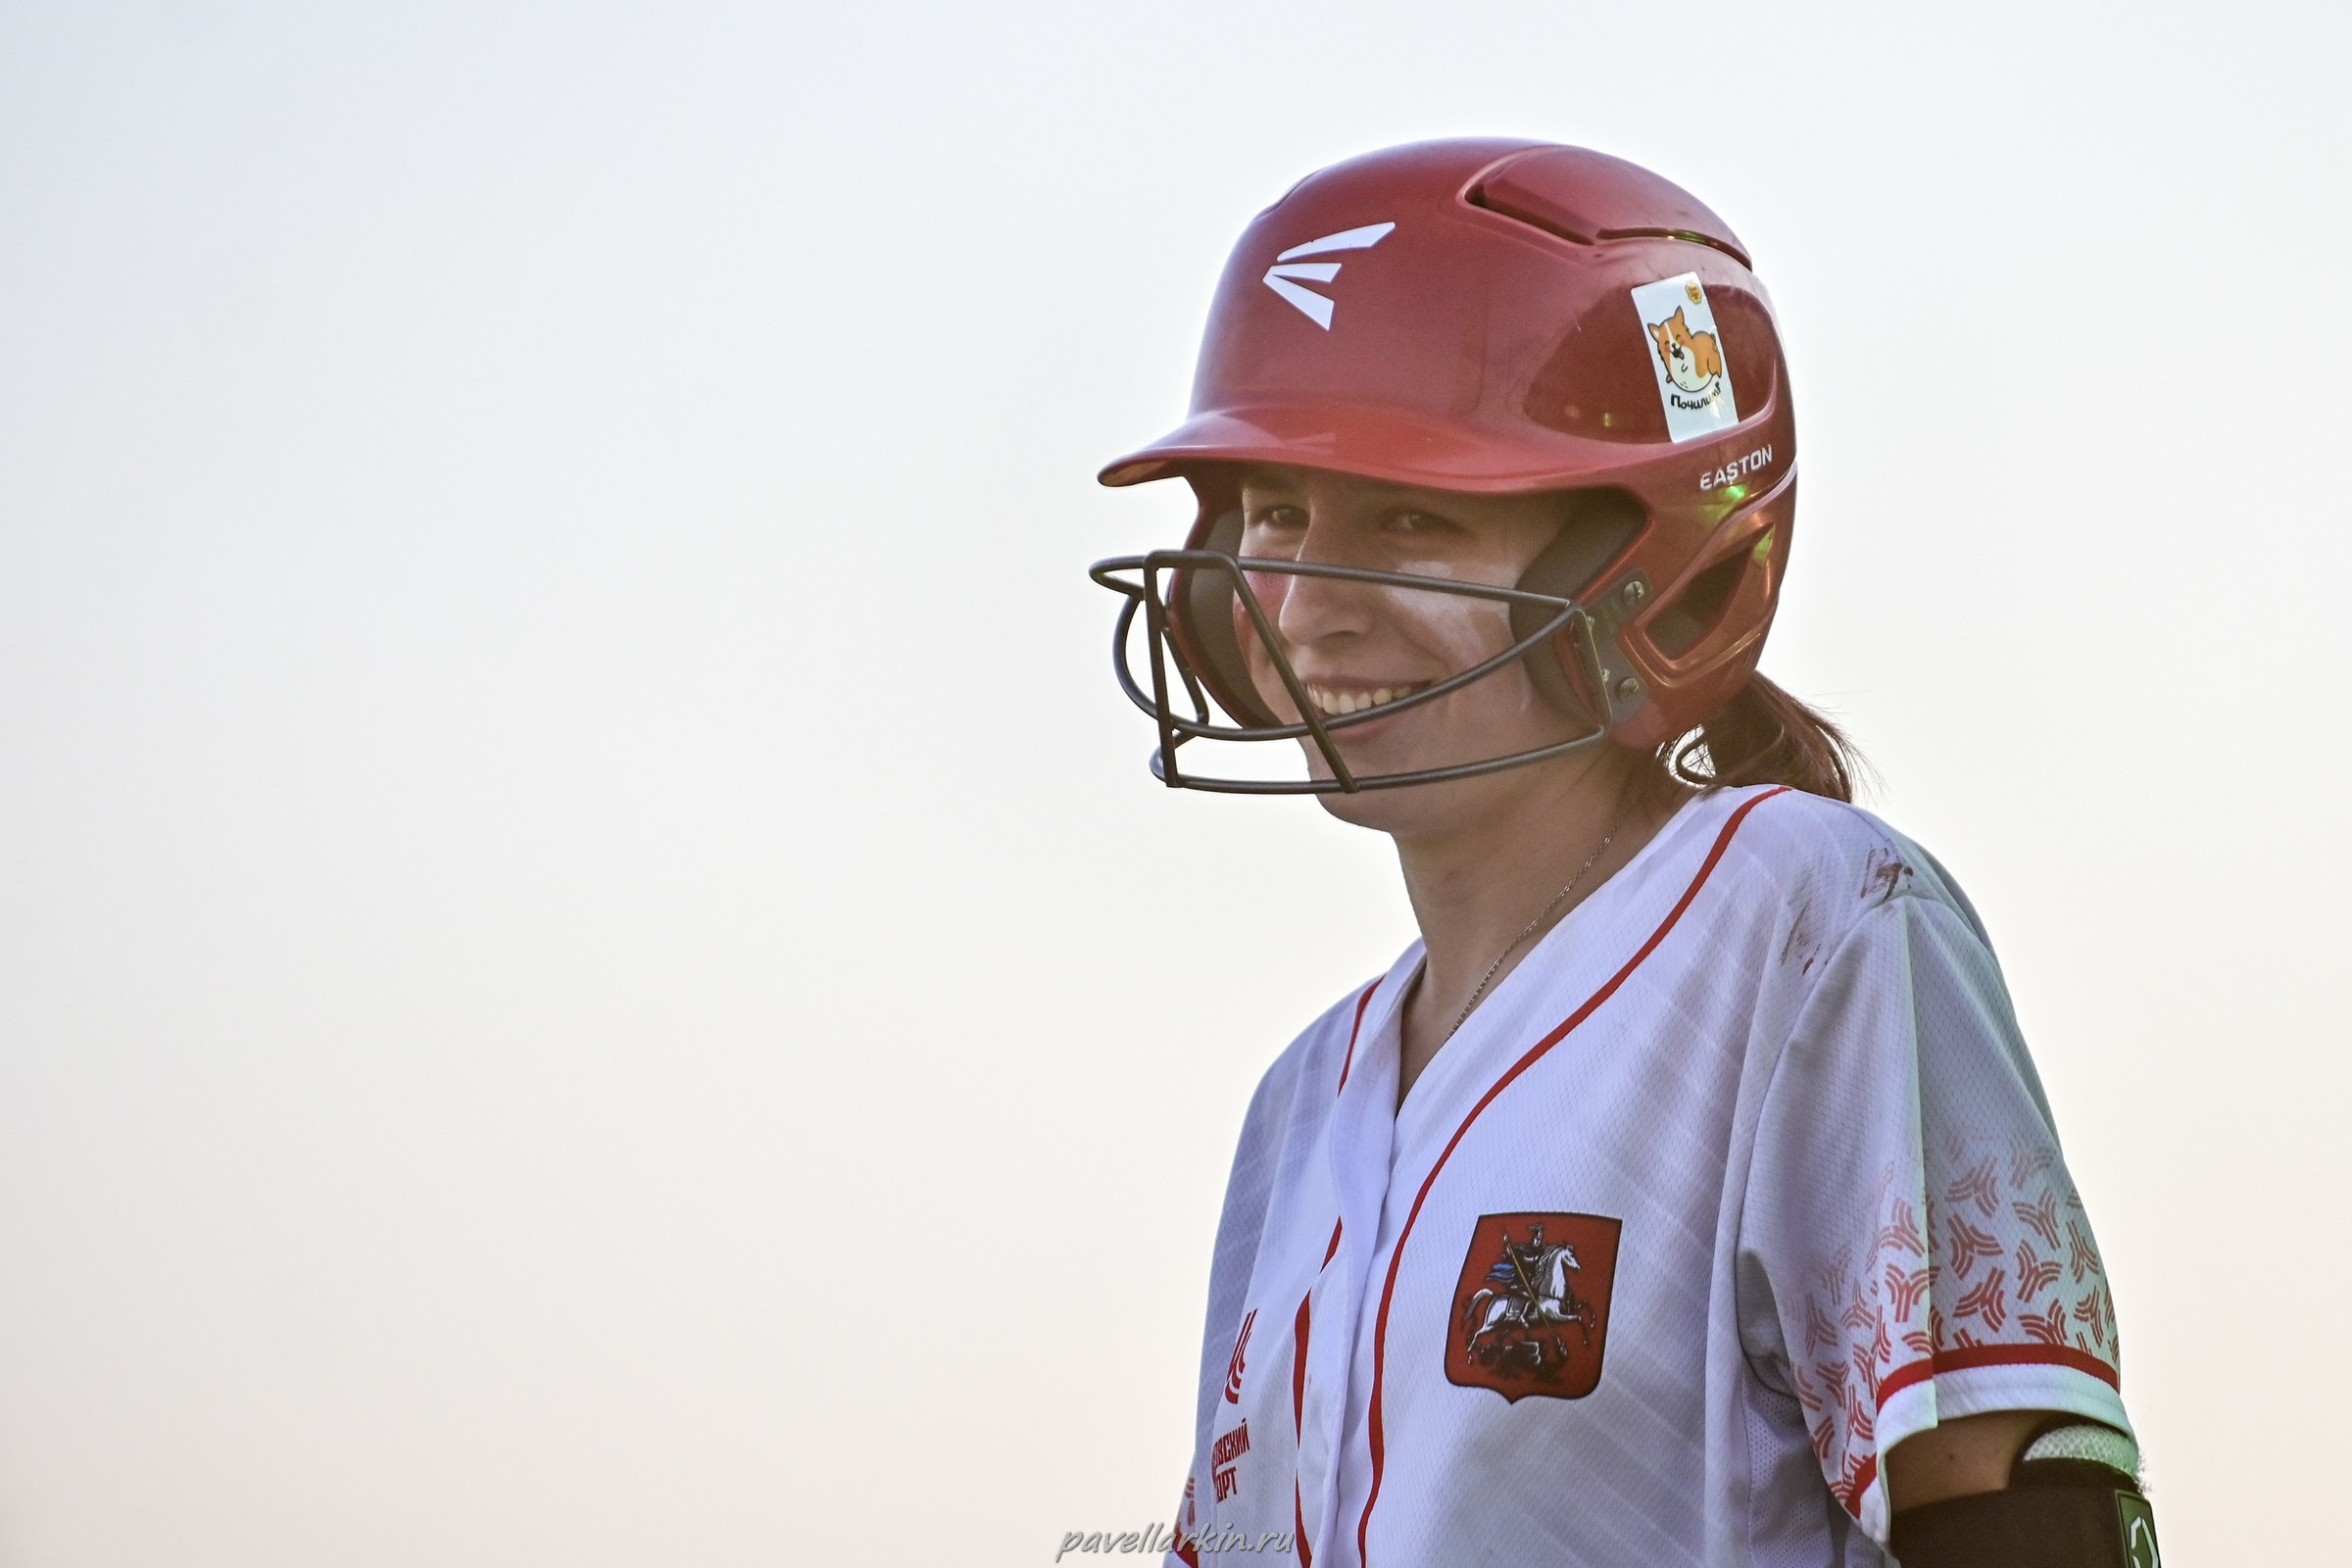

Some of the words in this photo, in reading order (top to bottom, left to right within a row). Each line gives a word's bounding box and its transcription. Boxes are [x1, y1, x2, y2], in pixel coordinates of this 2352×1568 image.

[1699, 443, 1772, 490] EASTON
[1211, 1417, 1250, 1472] ОВСКИЙ
[1215, 1466, 1238, 1503] ОРТ
